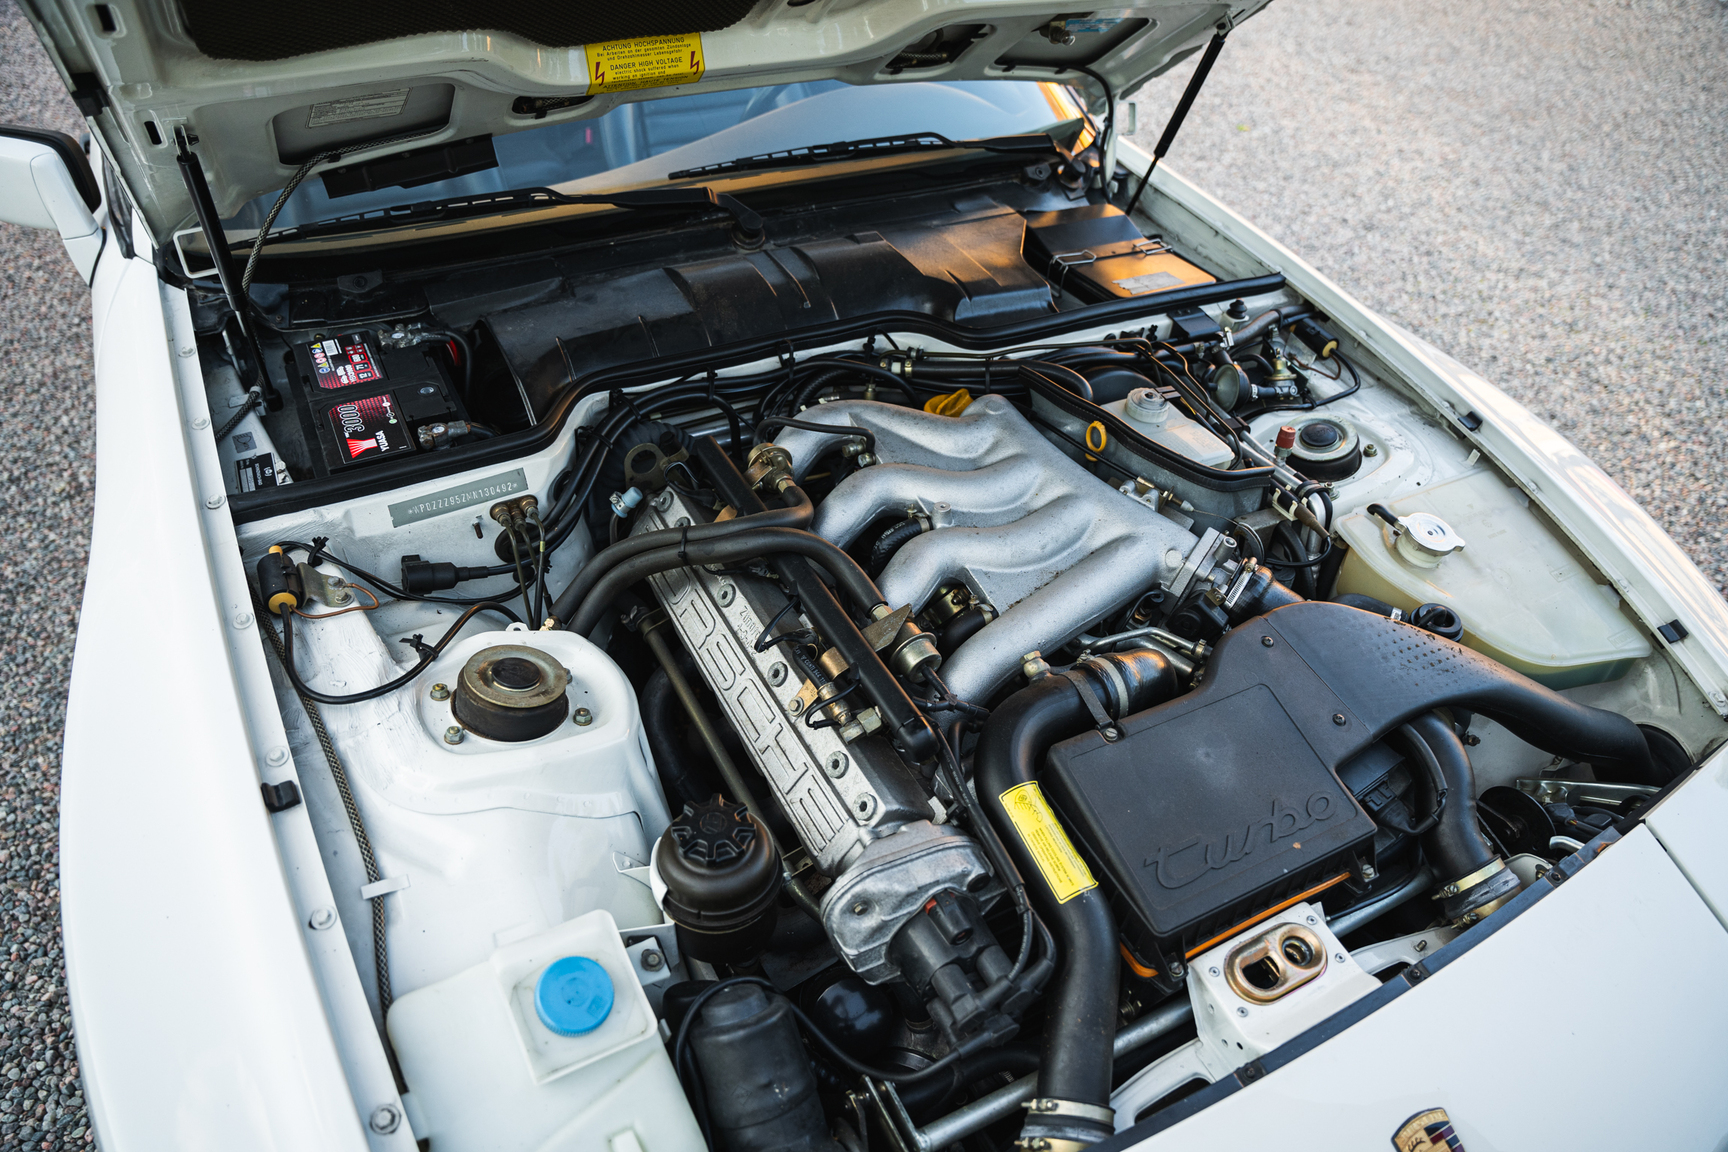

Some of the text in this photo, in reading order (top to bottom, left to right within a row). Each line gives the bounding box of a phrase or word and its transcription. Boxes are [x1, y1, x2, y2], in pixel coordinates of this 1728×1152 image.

[634, 37, 684, 47] HOCHSPANNUNG
[610, 62, 636, 70] DANGER
[338, 404, 365, 432] 3000
[376, 430, 390, 452] YUASA
[1144, 790, 1337, 890] turbo
